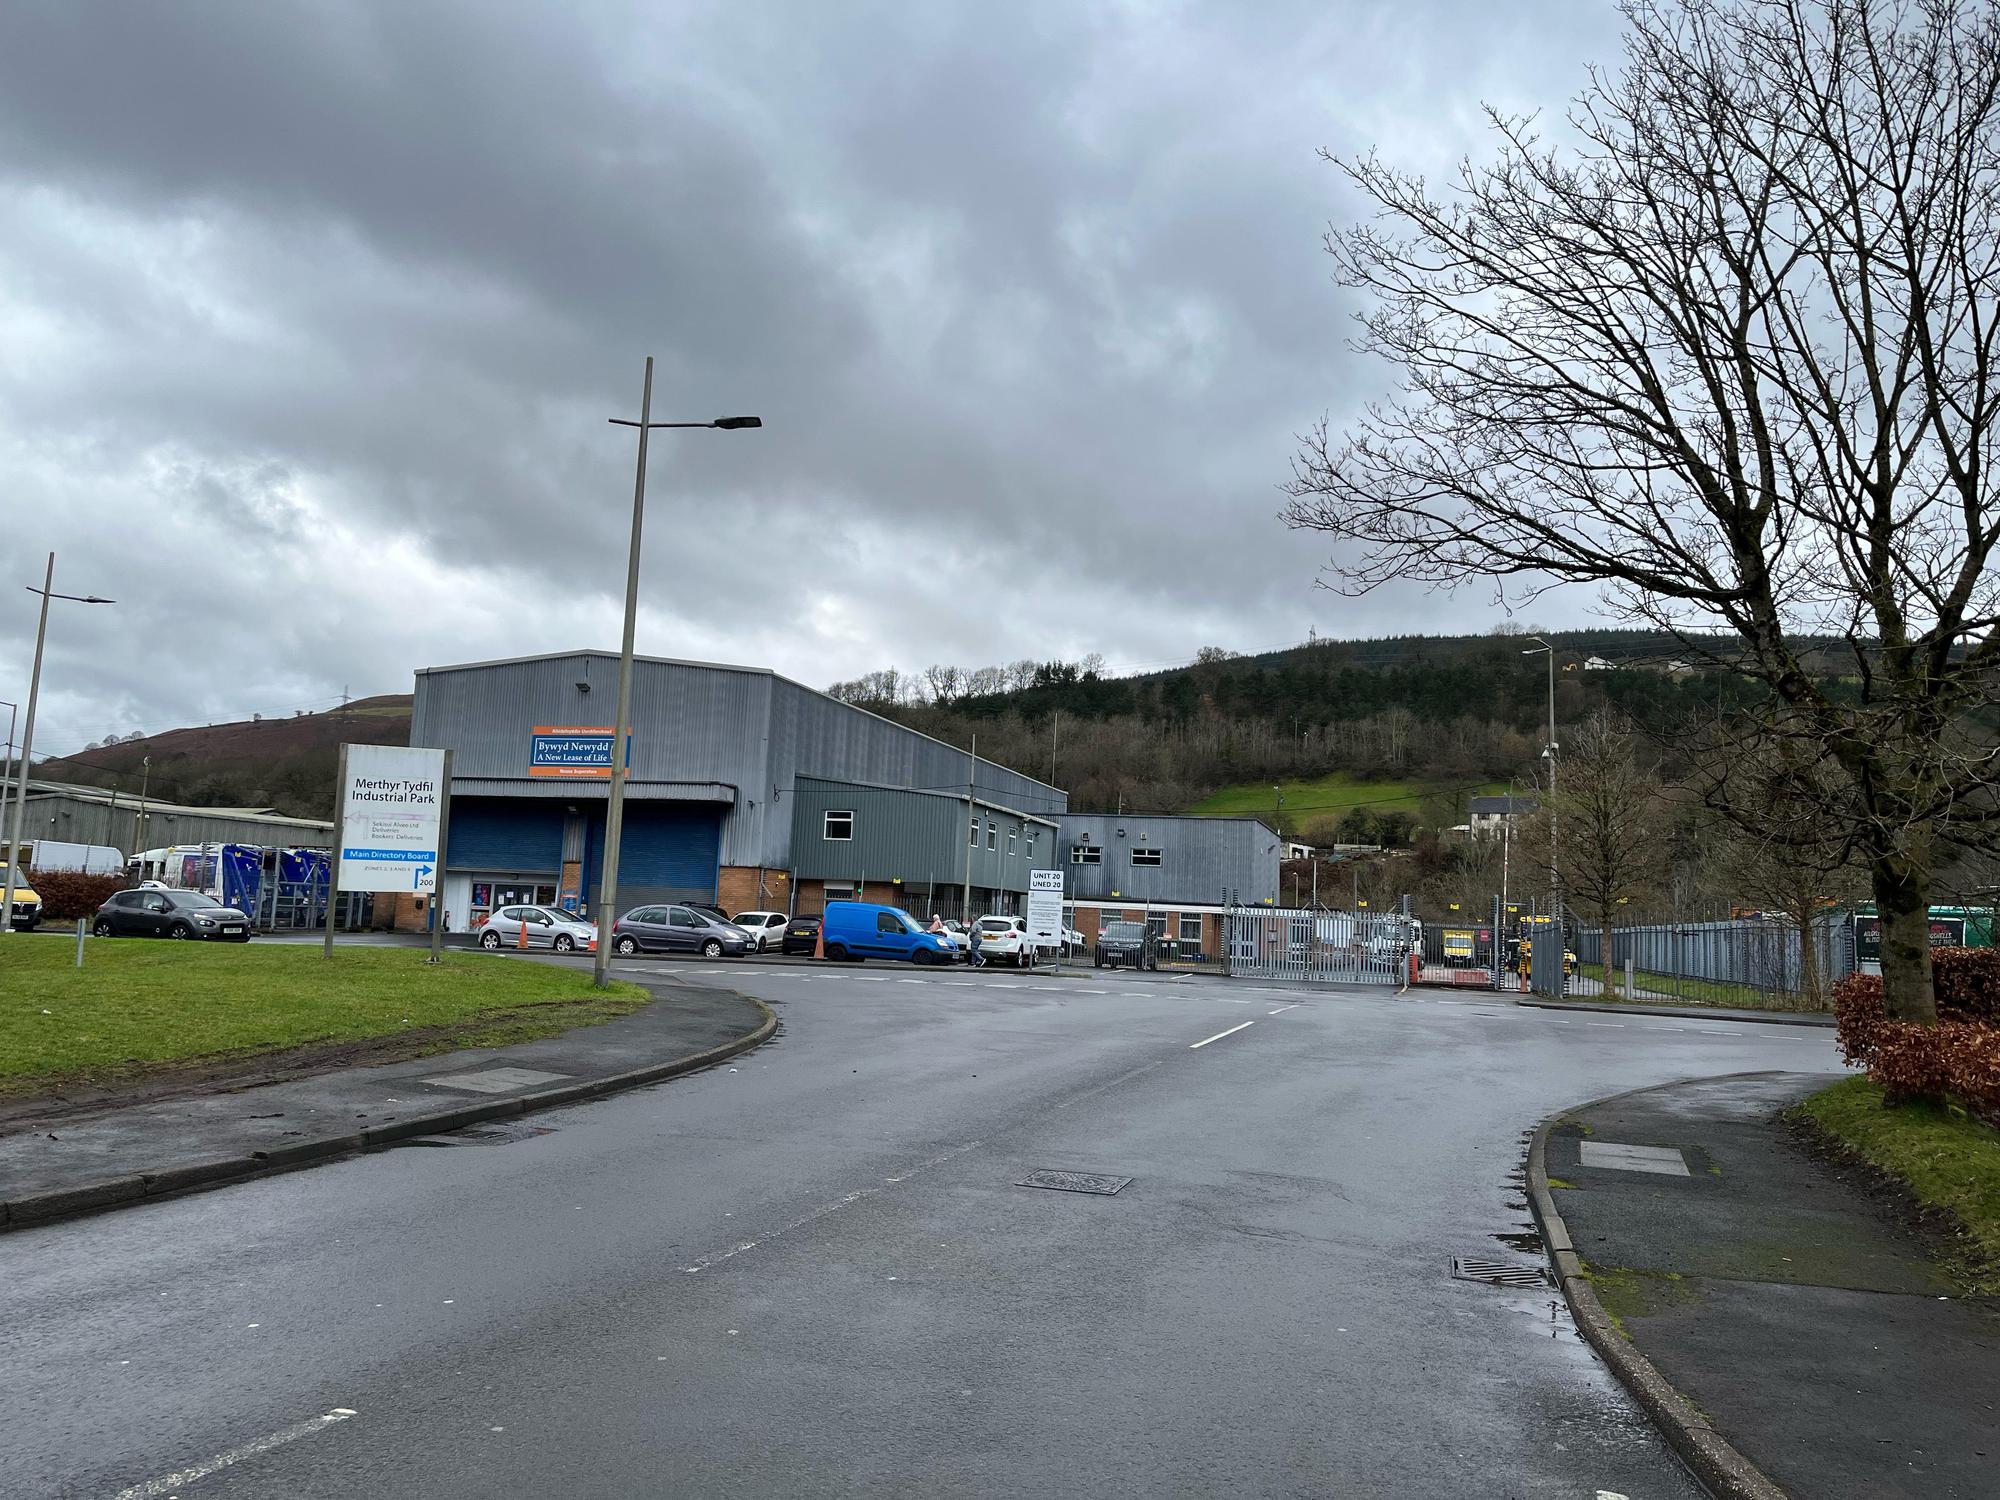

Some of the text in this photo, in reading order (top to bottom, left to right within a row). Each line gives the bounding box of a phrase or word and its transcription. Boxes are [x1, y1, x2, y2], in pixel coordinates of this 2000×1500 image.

[538, 741, 609, 753] Bywyd Newydd
[537, 753, 544, 761] A
[545, 753, 561, 761] New
[593, 754, 608, 762] Life
[355, 778, 434, 793] Merthyr Tydfil
[352, 790, 435, 804] Industrial Park
[350, 851, 370, 859] Main
[371, 852, 406, 860] Directory
